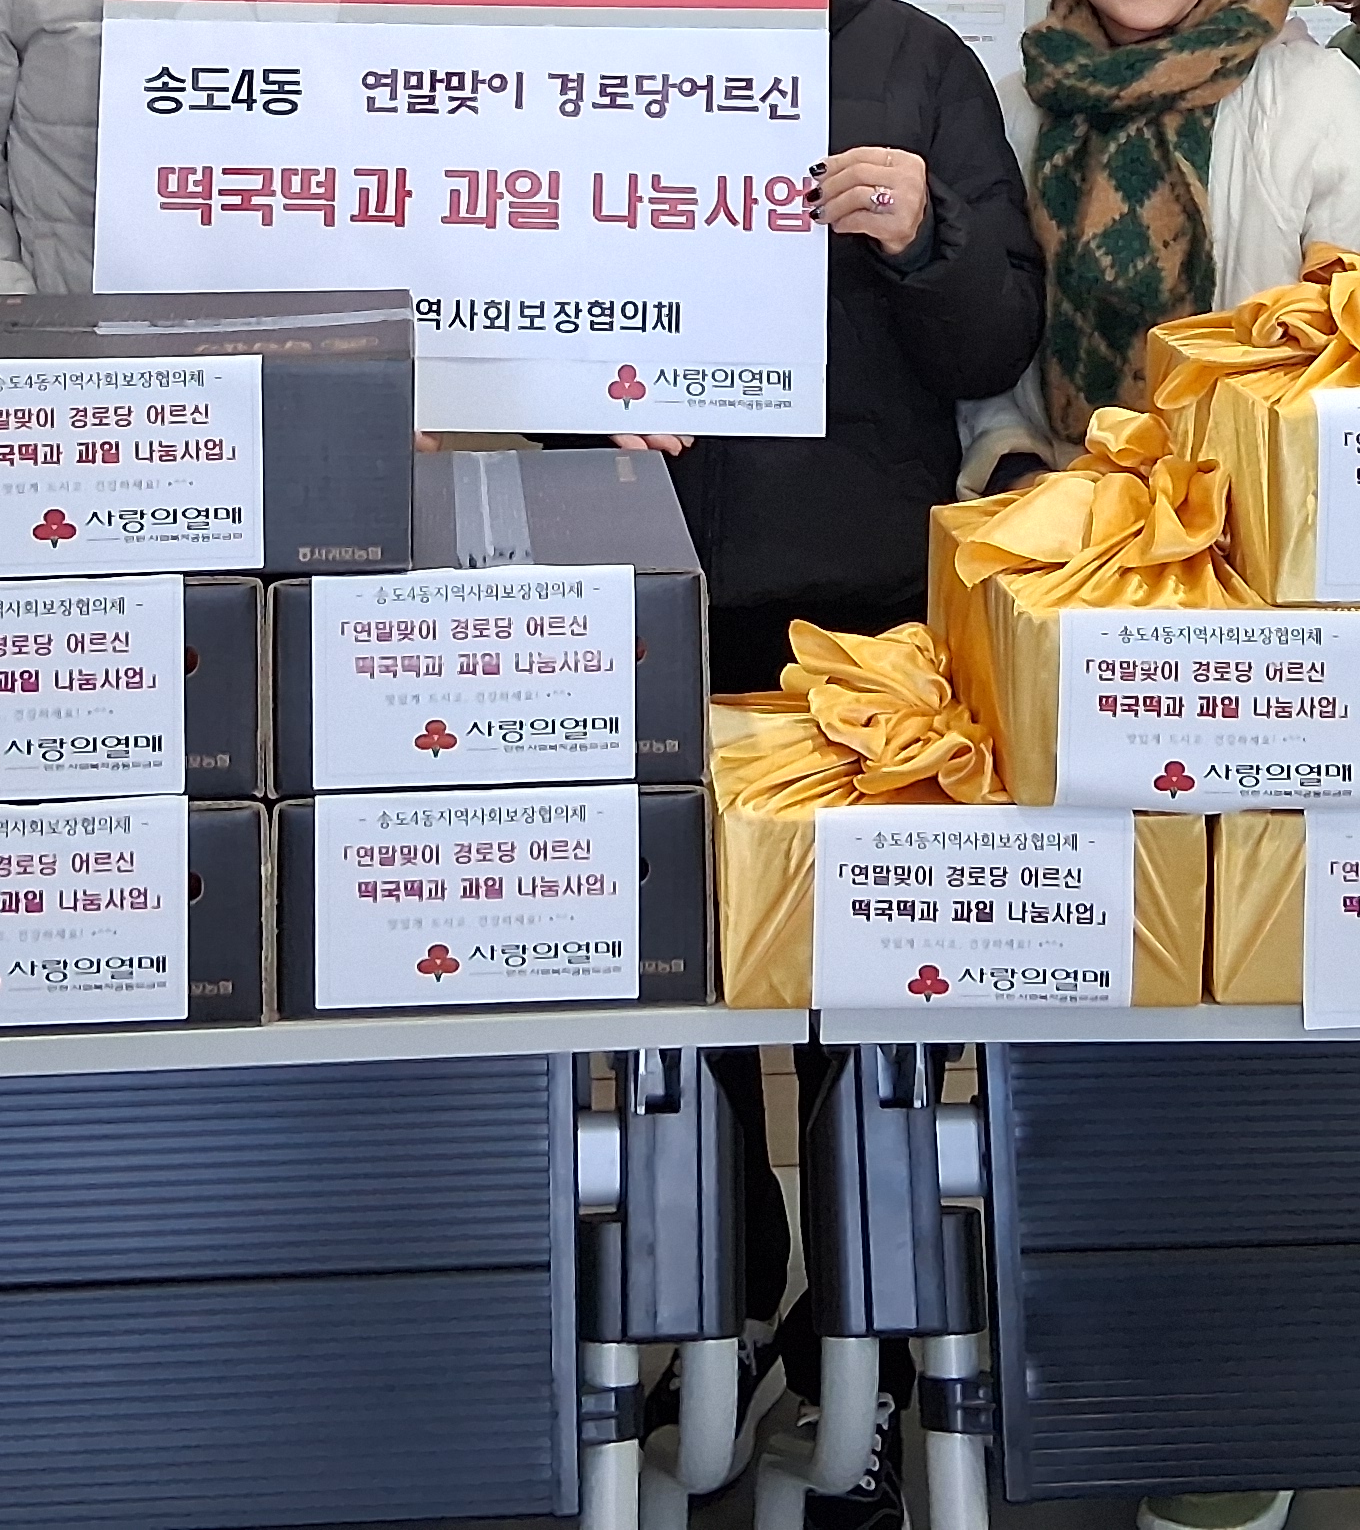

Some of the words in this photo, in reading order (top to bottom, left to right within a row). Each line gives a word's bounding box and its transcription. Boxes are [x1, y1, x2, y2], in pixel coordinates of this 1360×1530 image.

[143, 66, 302, 116] 송도4동
[361, 71, 523, 116] 연말맞이
[549, 72, 801, 120] 경로당어르신
[442, 169, 561, 230] 과일
[592, 172, 815, 232] 나눔사업
[654, 369, 791, 396] 사랑의열매
[450, 616, 513, 640] 경로당
[526, 614, 588, 638] 어르신
[355, 654, 442, 678] 떡국떡과
[456, 653, 500, 676] 과일
[514, 651, 614, 675] 나눔사업」
[465, 716, 620, 743] 사랑의열매
